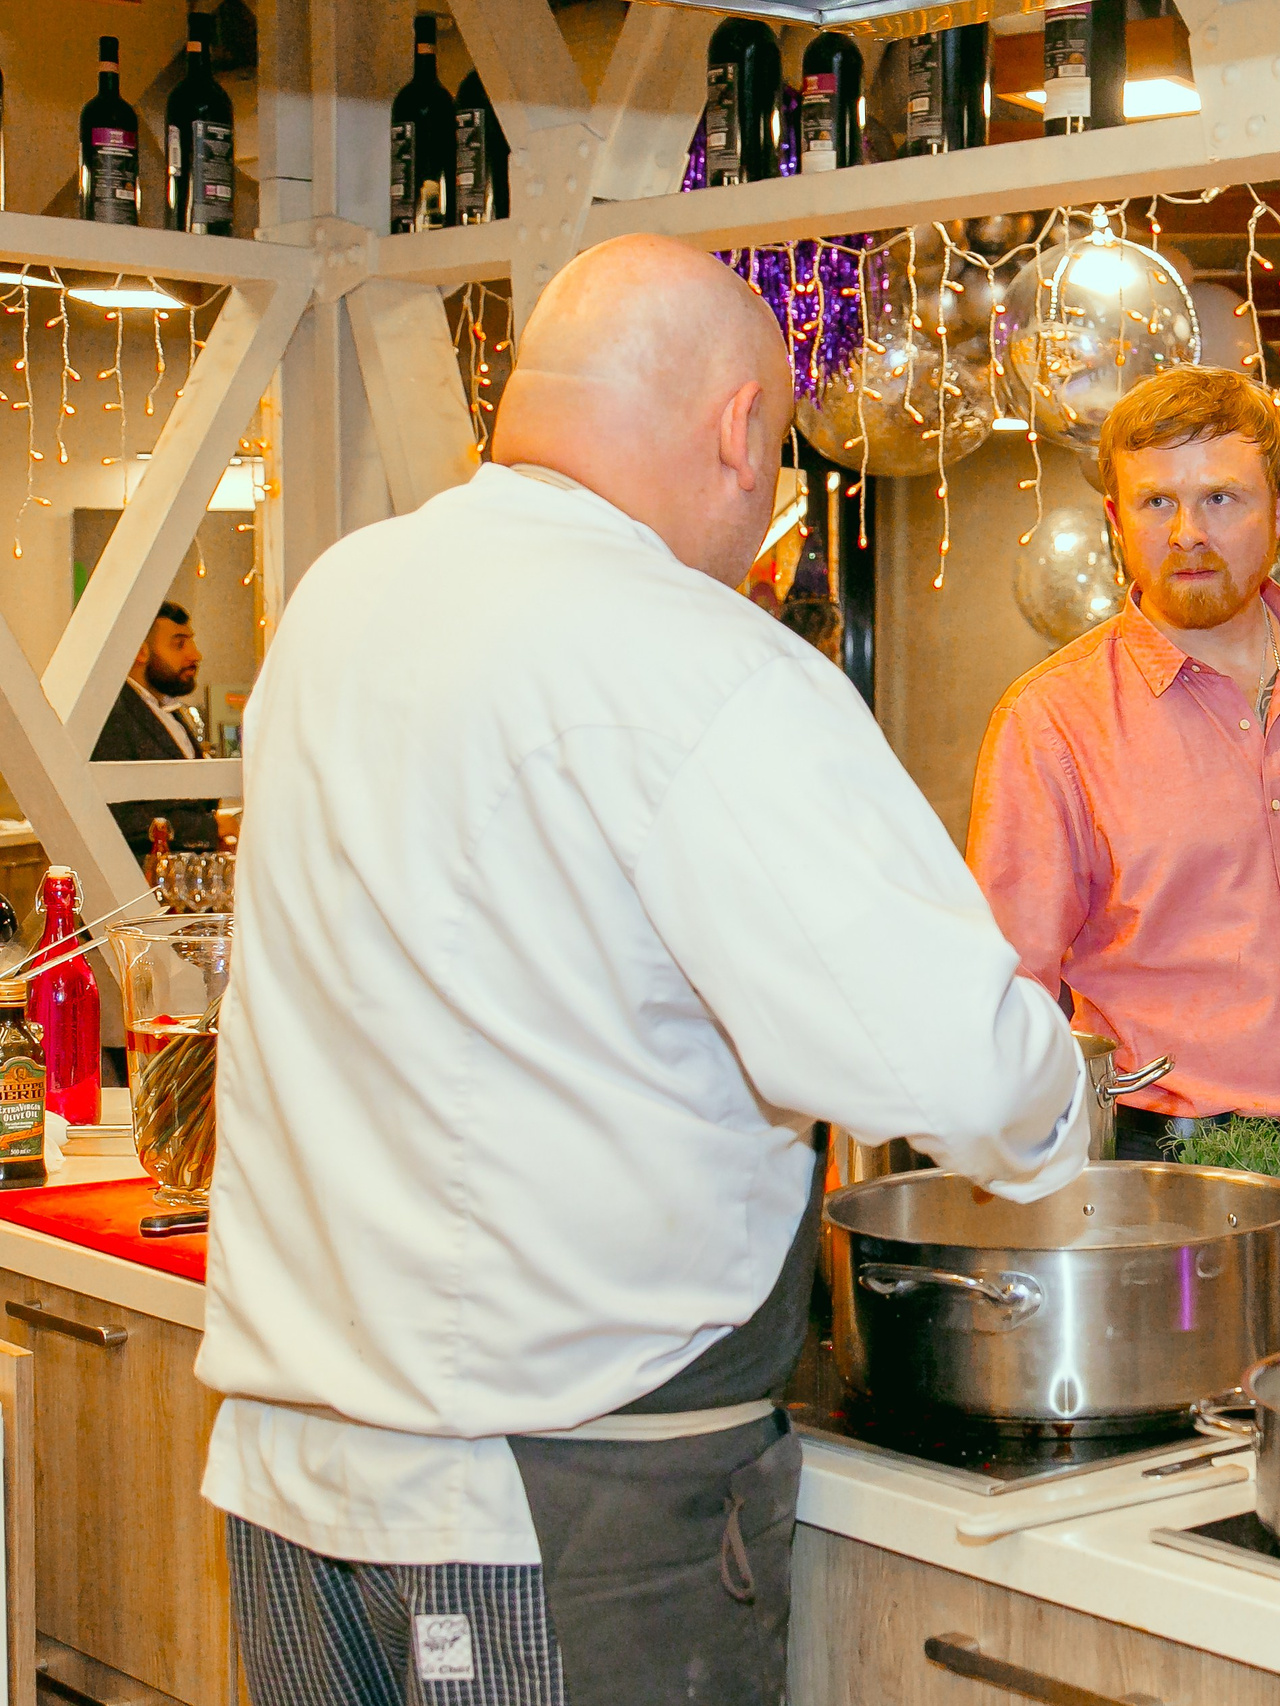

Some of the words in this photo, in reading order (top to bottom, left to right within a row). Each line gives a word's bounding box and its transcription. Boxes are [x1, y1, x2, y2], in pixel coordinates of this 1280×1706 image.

[0, 1082, 44, 1091] ILIPPO
[3, 1112, 26, 1122] OLIVE
[25, 1110, 38, 1118] OIL
